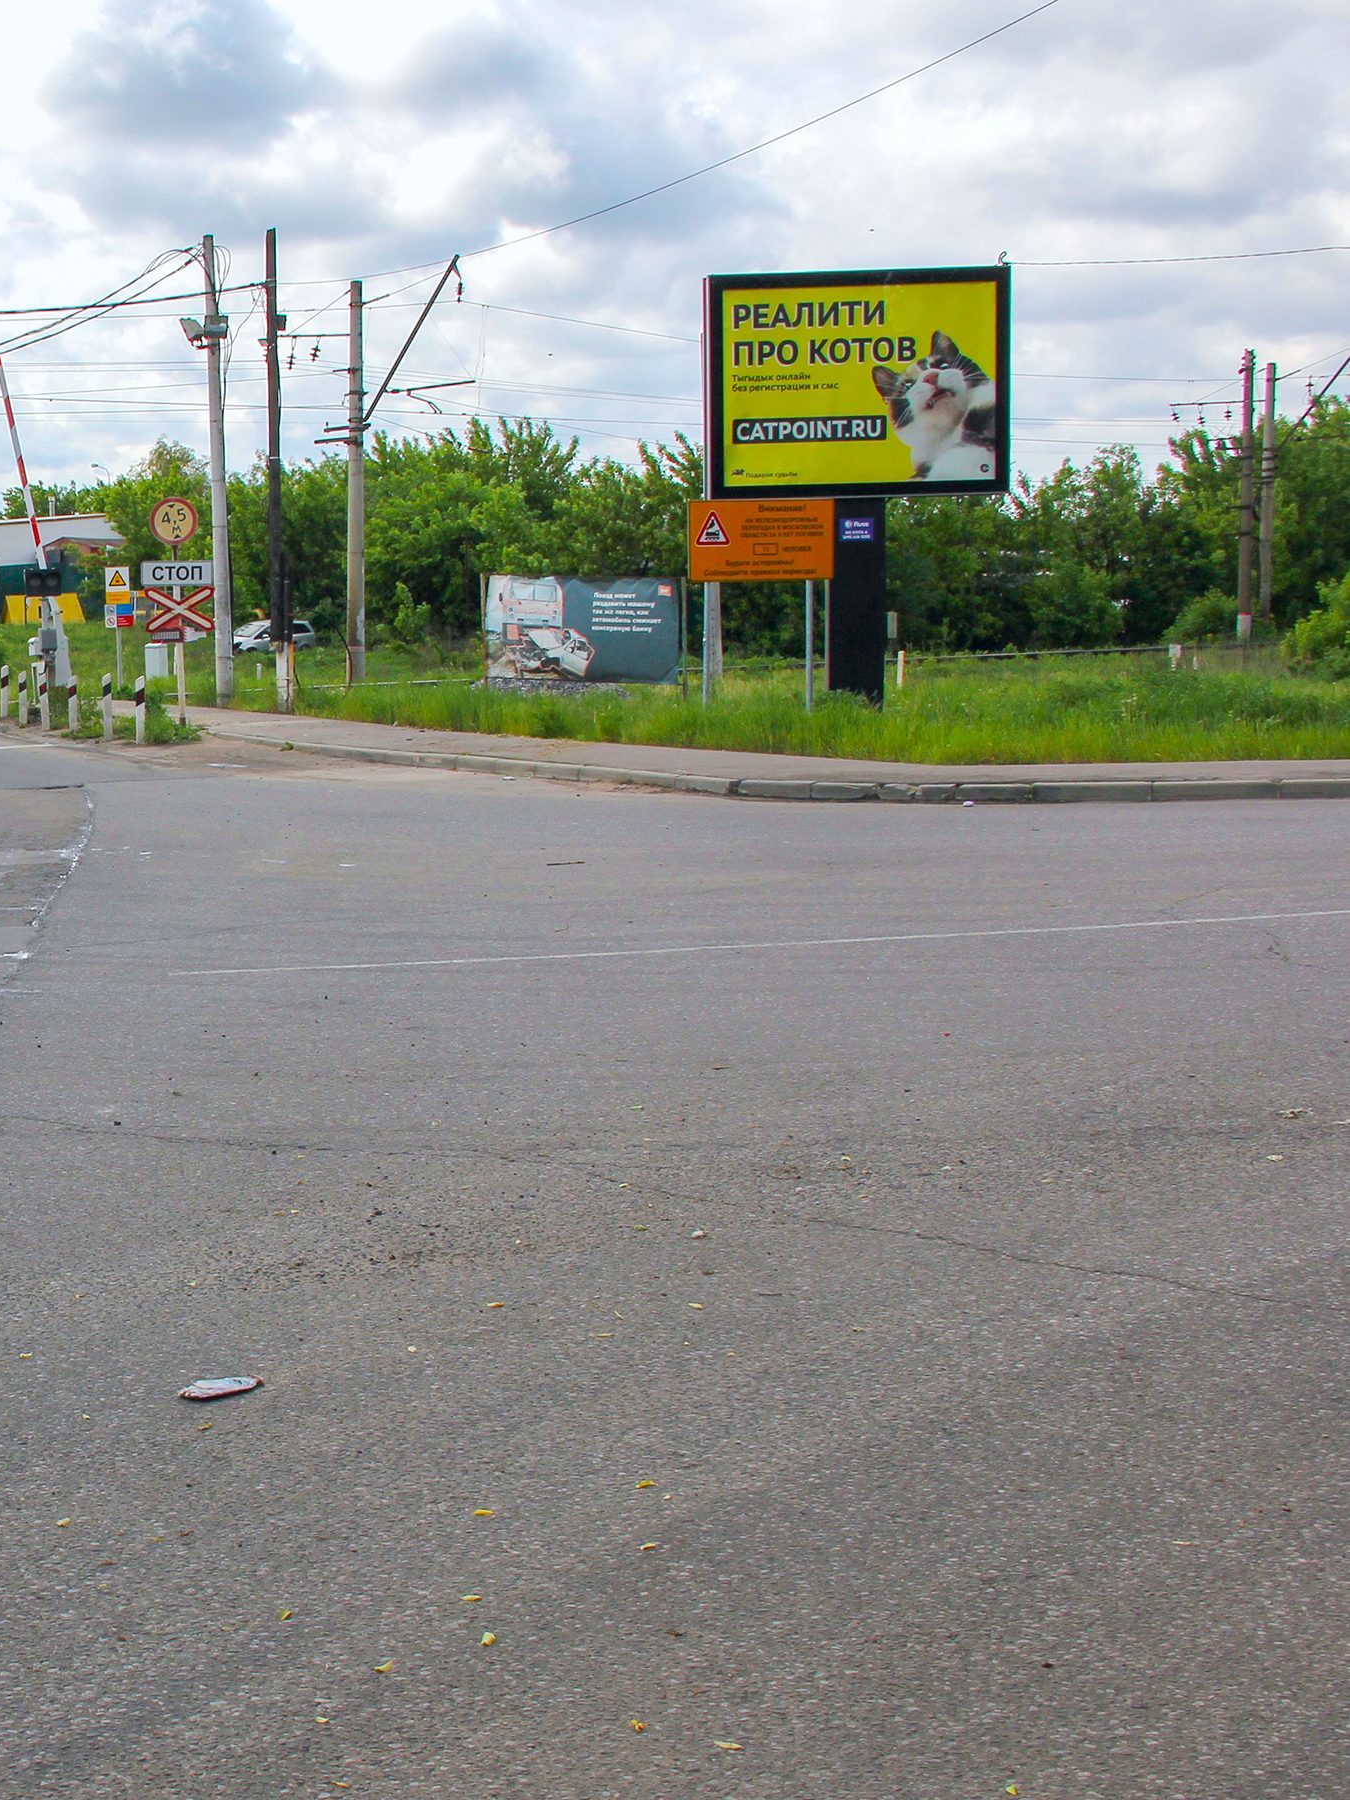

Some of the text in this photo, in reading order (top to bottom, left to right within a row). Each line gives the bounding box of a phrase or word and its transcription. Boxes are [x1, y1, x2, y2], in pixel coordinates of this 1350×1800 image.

[732, 300, 885, 330] РЕАЛИТИ
[732, 336, 917, 367] ПРО КОТОВ
[731, 372, 811, 383] Тыгыдык онлайн
[731, 383, 747, 392] без
[749, 383, 811, 393] регистрации
[821, 382, 839, 390] смс
[736, 418, 883, 442] CATPOINT.RU
[758, 504, 807, 513] Внимание!
[152, 566, 202, 581] СТОП
